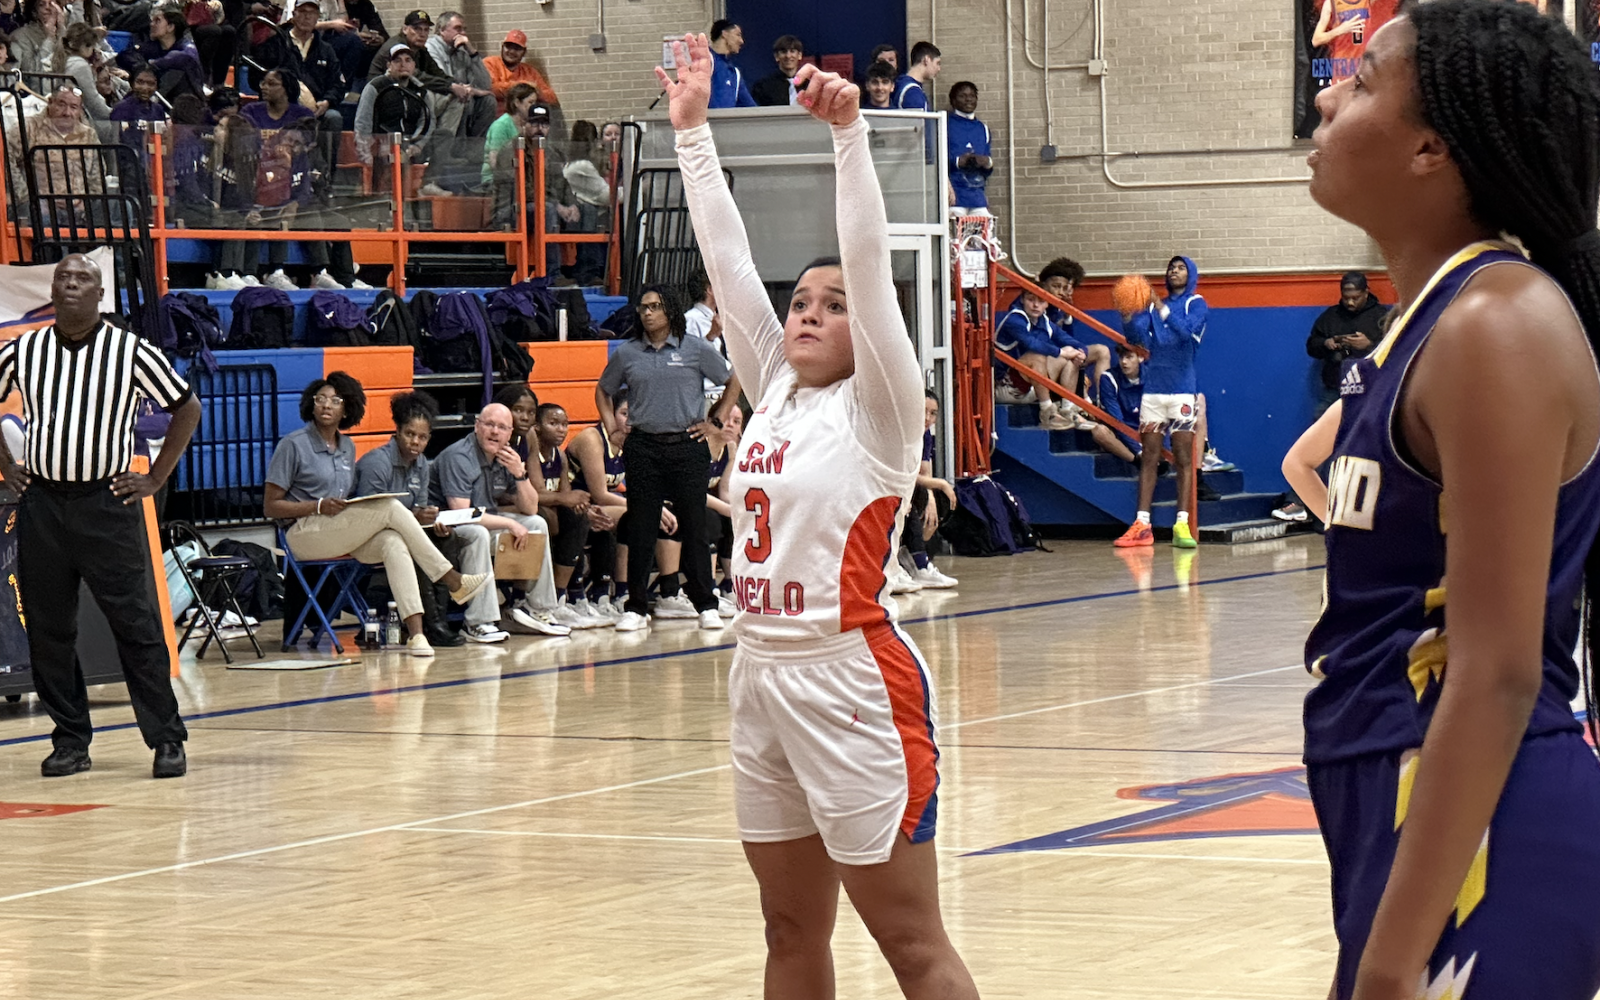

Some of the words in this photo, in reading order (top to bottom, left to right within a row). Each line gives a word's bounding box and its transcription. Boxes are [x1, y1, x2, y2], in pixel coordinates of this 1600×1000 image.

[738, 440, 791, 474] SAN
[744, 487, 772, 563] 3
[733, 574, 804, 616] NGELO
